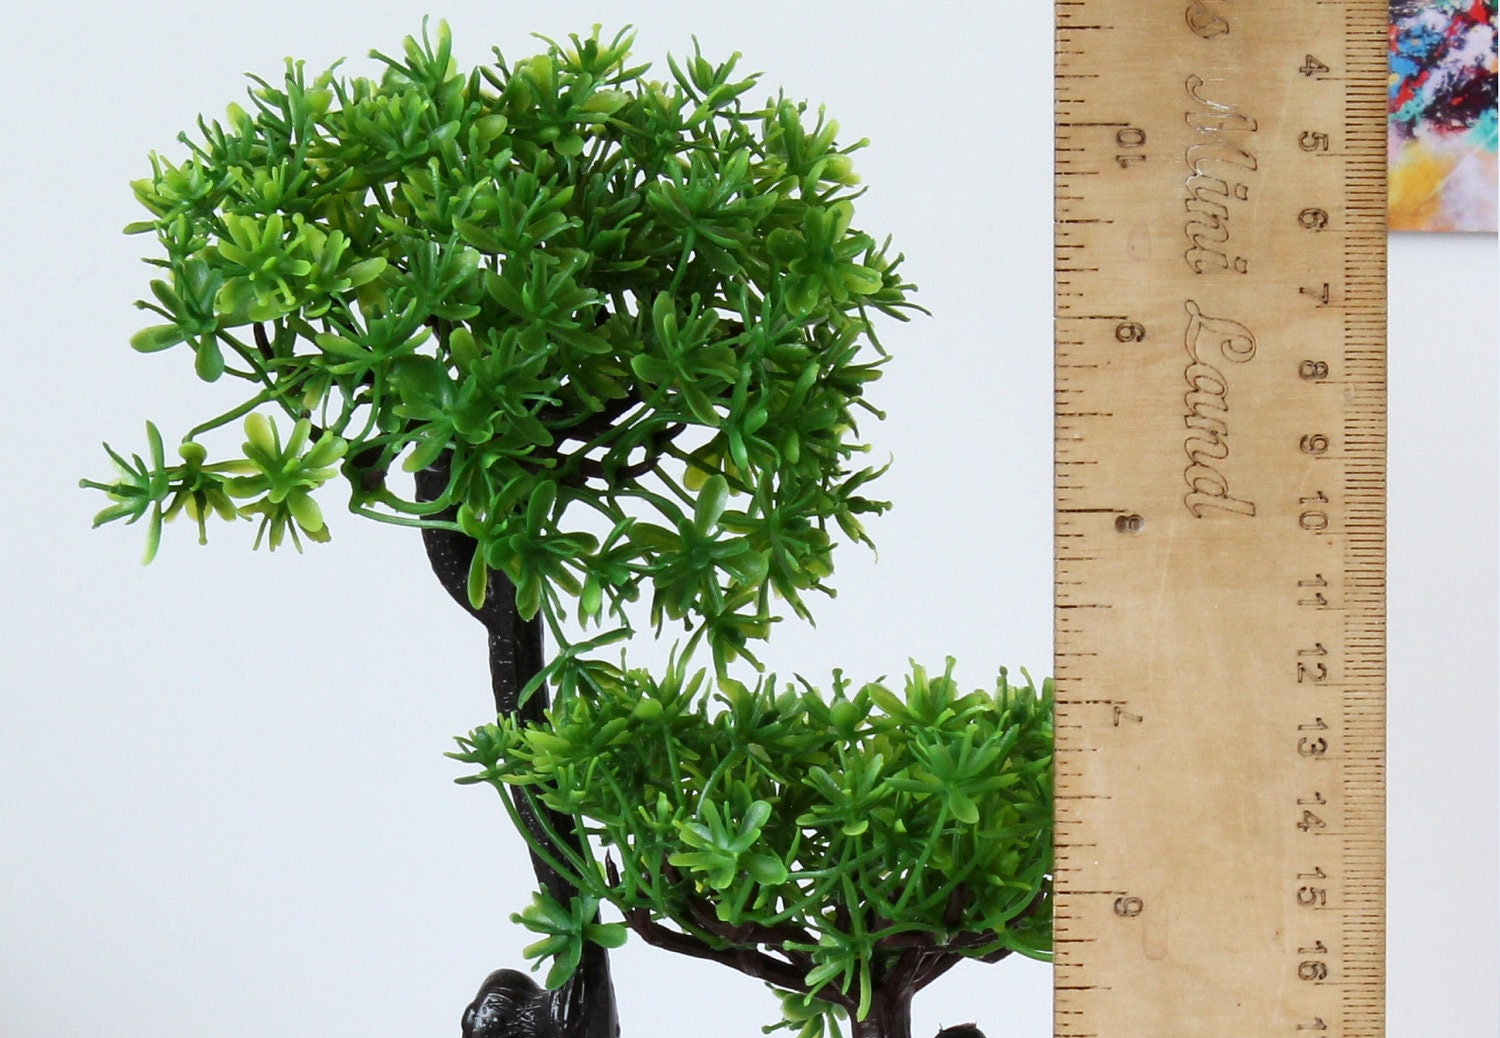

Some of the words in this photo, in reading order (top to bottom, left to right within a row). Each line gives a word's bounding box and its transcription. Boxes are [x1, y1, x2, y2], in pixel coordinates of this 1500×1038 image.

[1298, 54, 1330, 77] 4
[1115, 128, 1146, 168] 10
[1298, 130, 1330, 152] 5
[1184, 73, 1258, 274] Mini
[1298, 208, 1329, 229] 6
[1298, 283, 1329, 304] 7
[1115, 321, 1146, 344] 9
[1298, 360, 1329, 381] 8
[1184, 299, 1256, 519] Land
[1297, 433, 1329, 455] 9
[1113, 513, 1145, 535] 8
[1297, 490, 1329, 532] 10
[1297, 573, 1329, 608] 11
[1297, 642, 1328, 684] 12
[1113, 706, 1145, 727] 7
[1297, 717, 1328, 759] 13
[1297, 791, 1328, 833] 14
[1296, 866, 1328, 908] 15
[1113, 896, 1145, 917] 6
[1296, 940, 1328, 982] 16
